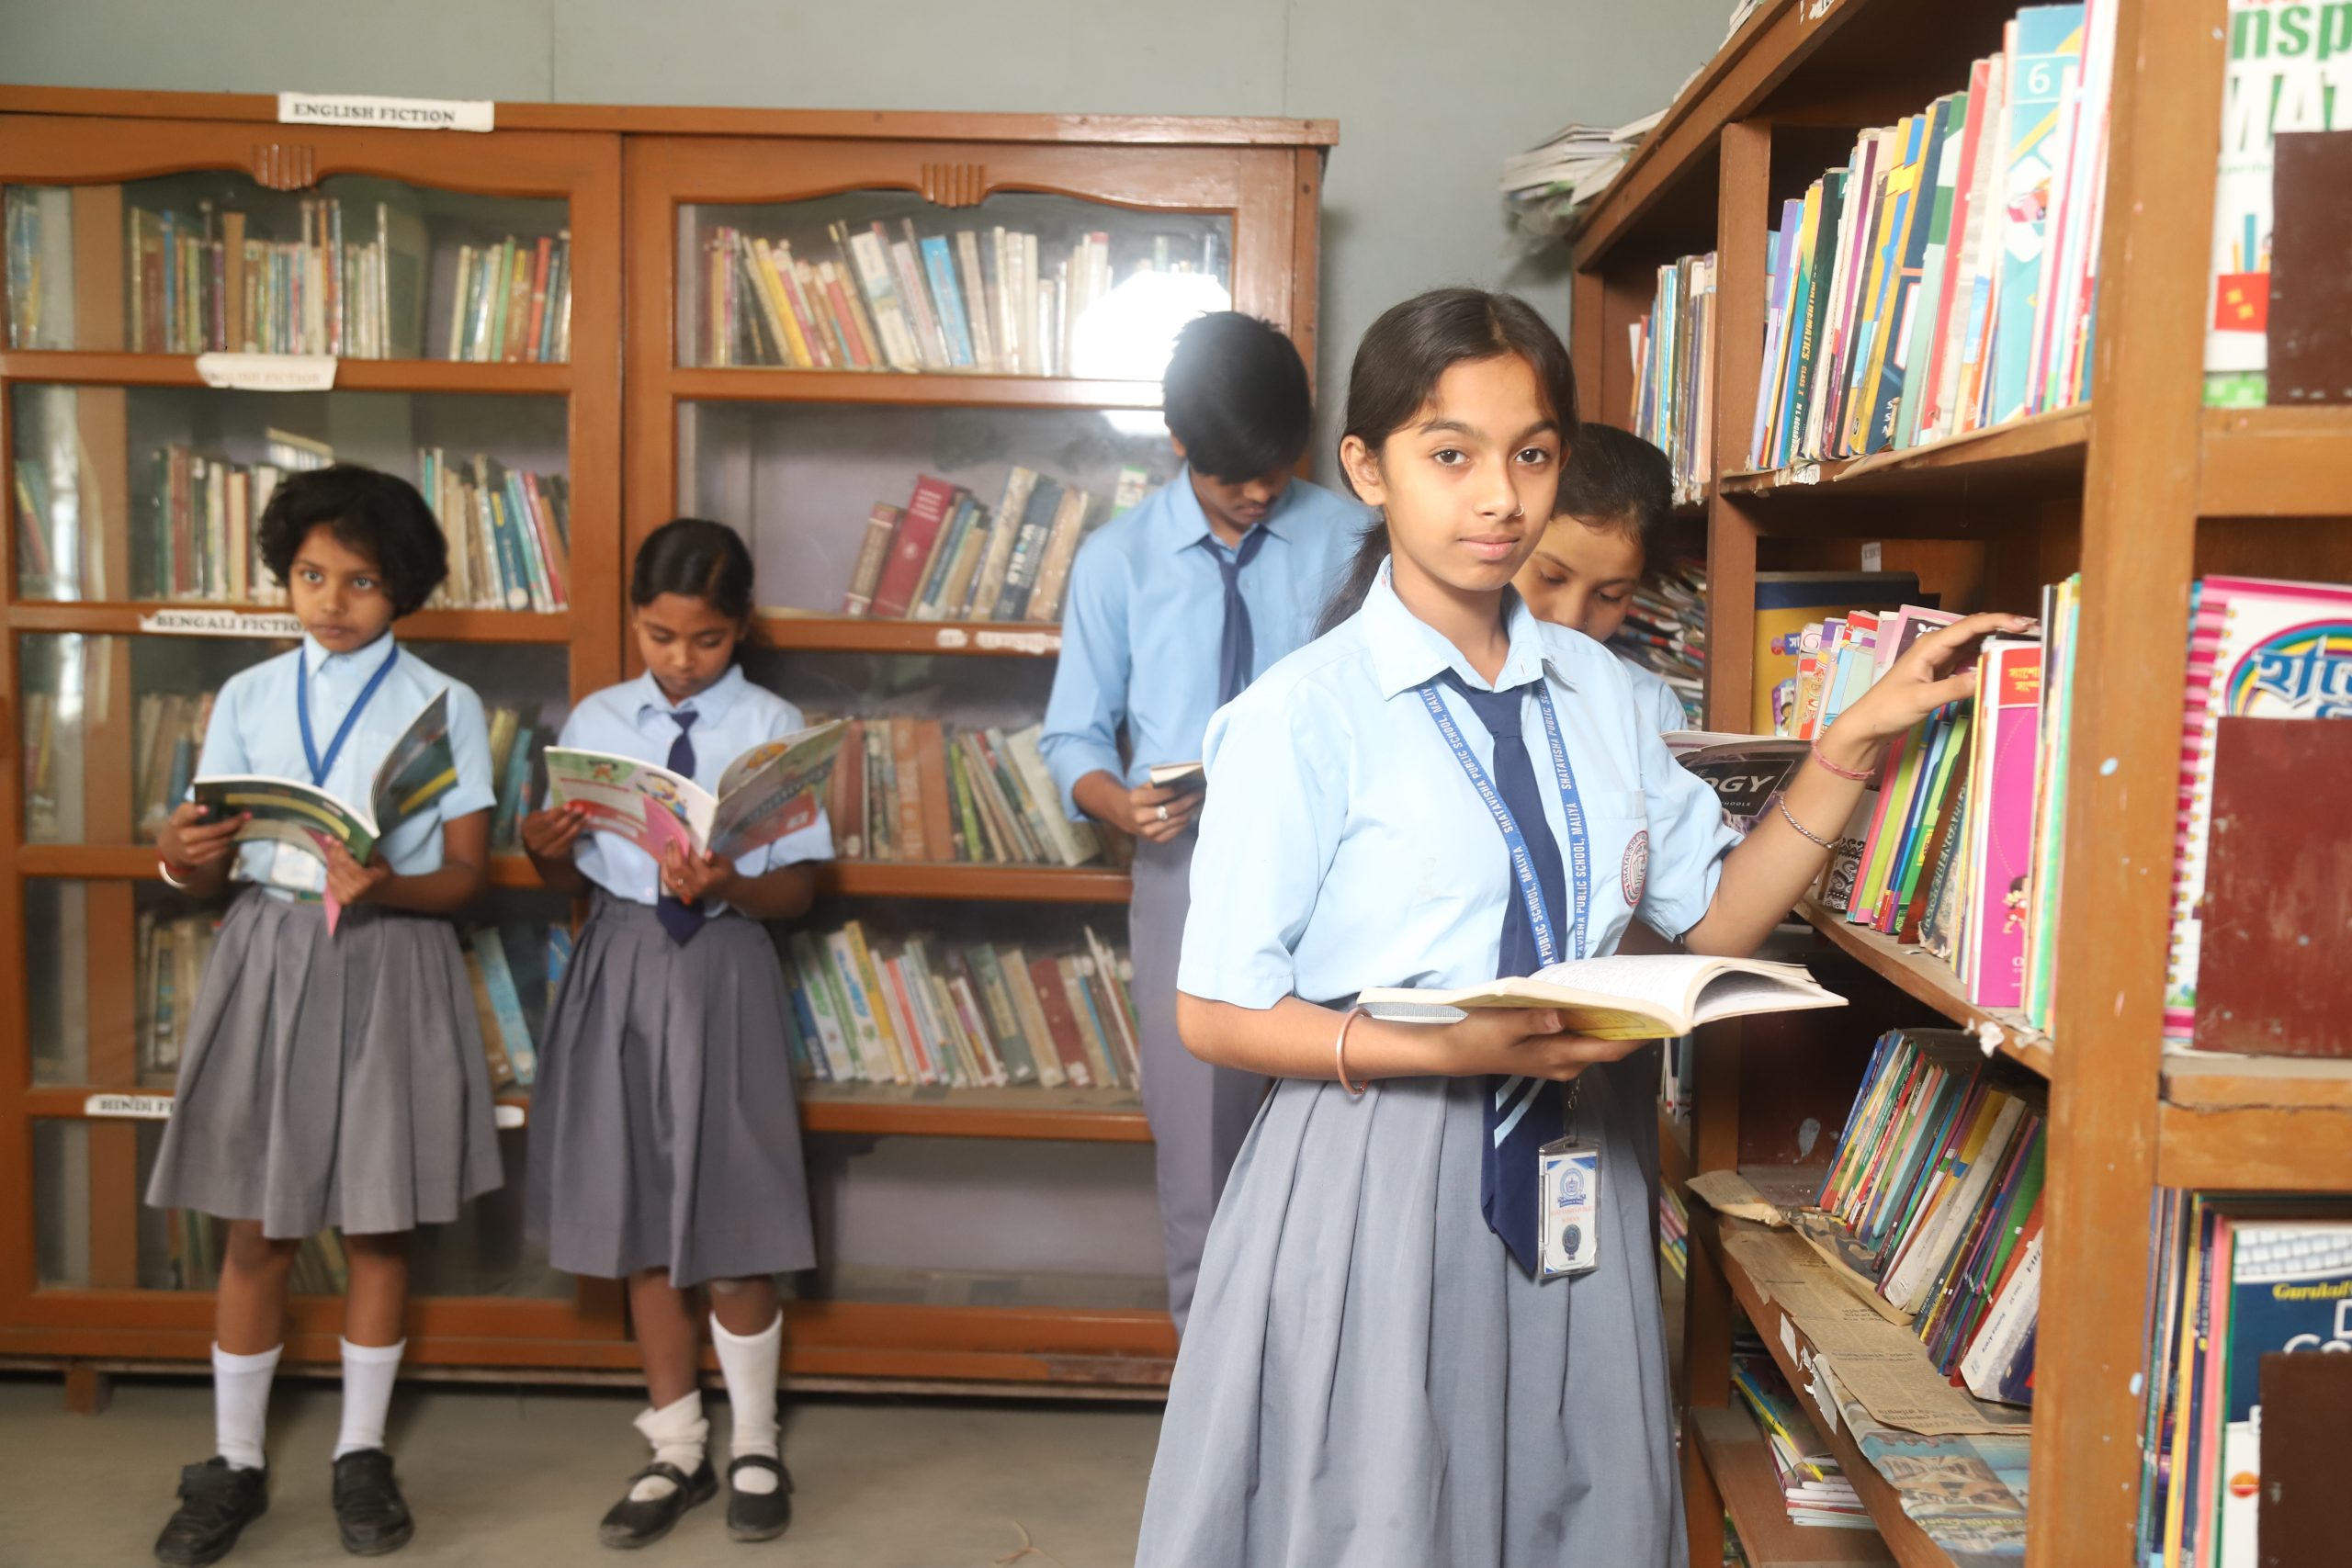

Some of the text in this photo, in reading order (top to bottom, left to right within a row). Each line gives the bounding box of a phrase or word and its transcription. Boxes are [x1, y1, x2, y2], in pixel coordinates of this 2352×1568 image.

[2232, 3, 2352, 62] nsp
[2028, 61, 2051, 95] 6
[294, 102, 456, 123] ENGLISH FICTION
[1799, 366, 1807, 388] CLASS
[156, 615, 303, 632] BENGALI FICTIO
[1543, 706, 1557, 736] PUBLIC
[1421, 687, 1514, 834] SHATAVISHA PUBLIC SCHOOL, MALIY
[1551, 739, 1572, 790] SHATAVISHA
[1512, 845, 1533, 884] MALIYA
[1566, 802, 1589, 957] TAVISHA PUBLIC SCHOOL, MALIYA
[1526, 882, 1544, 923] SCHOOL,
[1534, 923, 1554, 957] PUBLIC
[101, 1100, 153, 1111] HINDI
